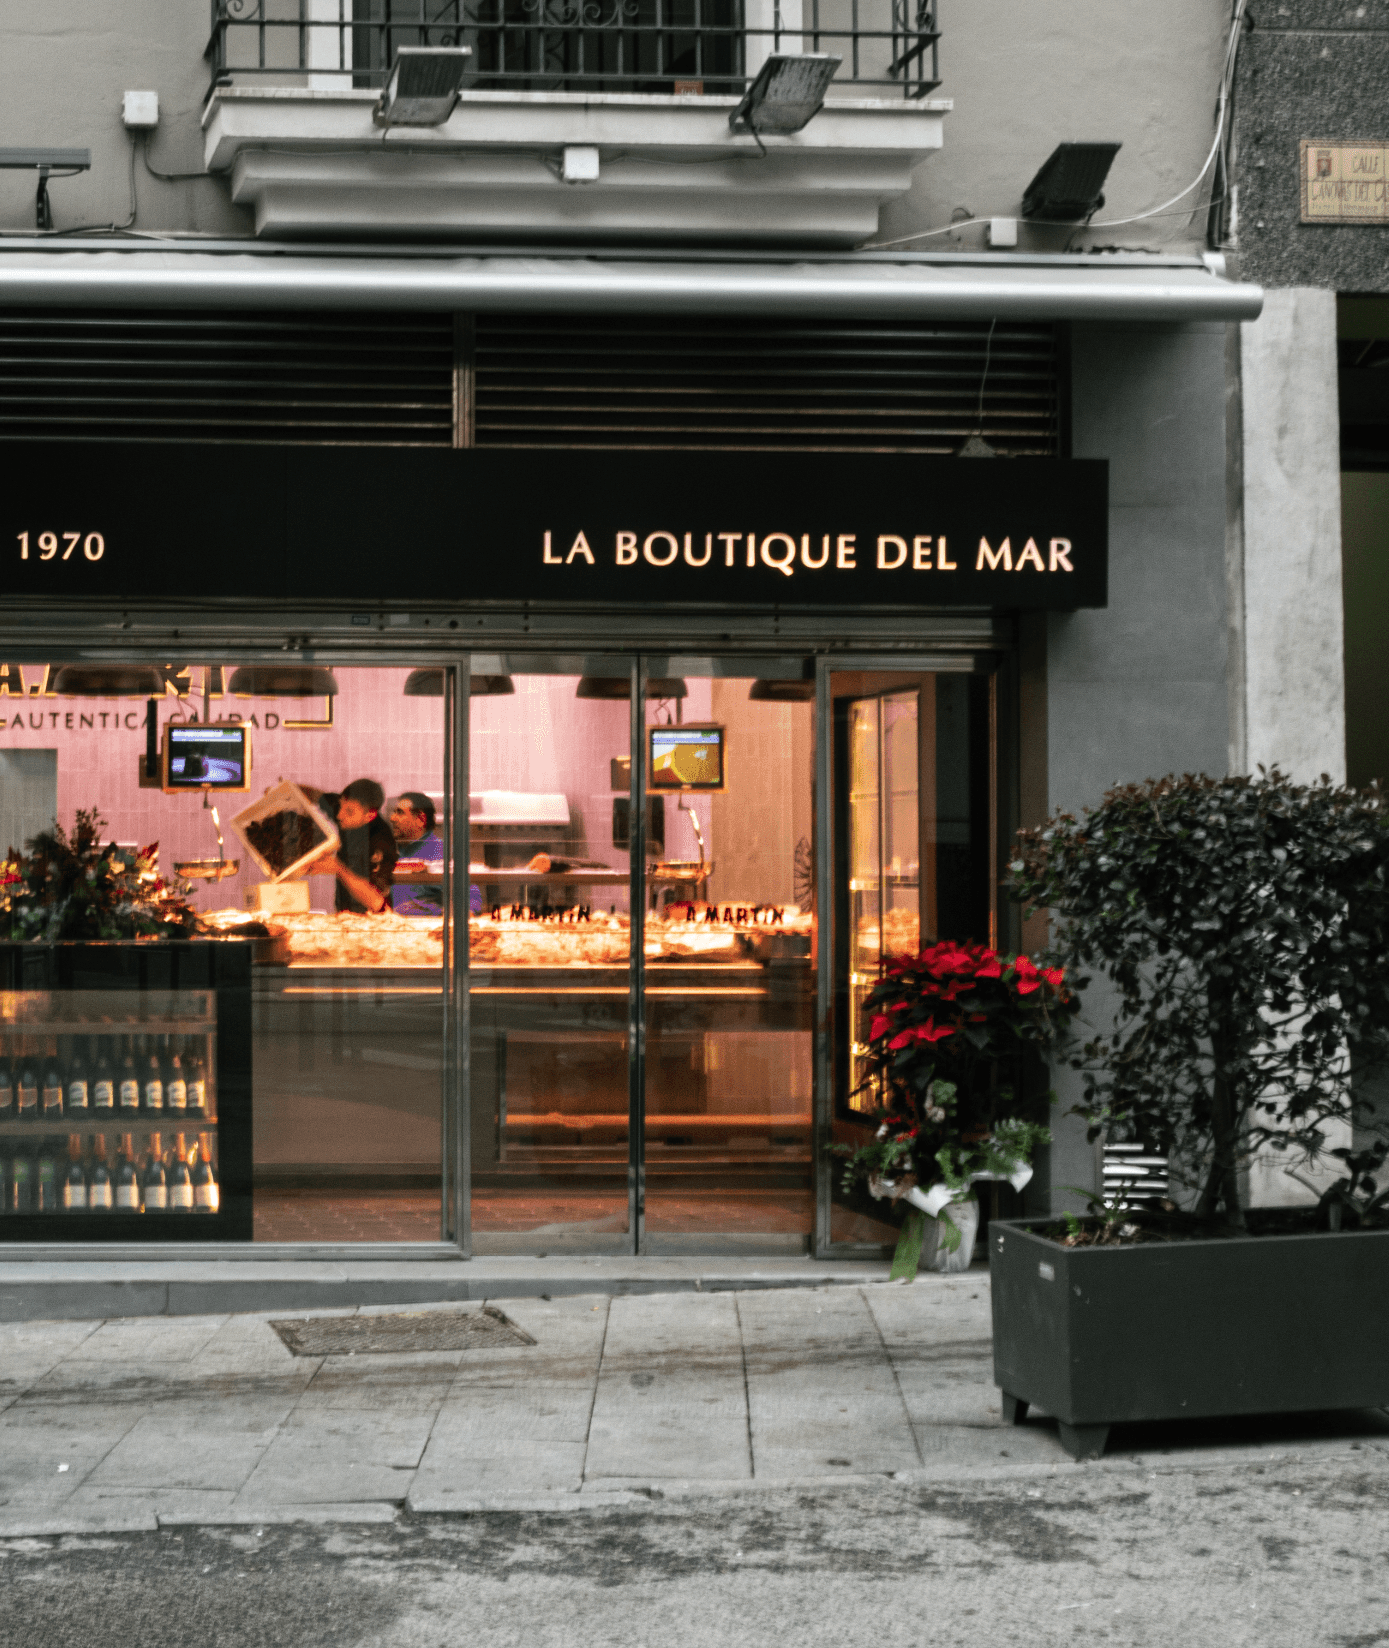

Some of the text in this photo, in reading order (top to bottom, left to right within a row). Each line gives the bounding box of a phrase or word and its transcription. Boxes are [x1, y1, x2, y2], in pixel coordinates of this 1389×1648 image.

[16, 529, 106, 562] 1970
[543, 529, 1075, 577] LA BOUTIQUE DEL MAR
